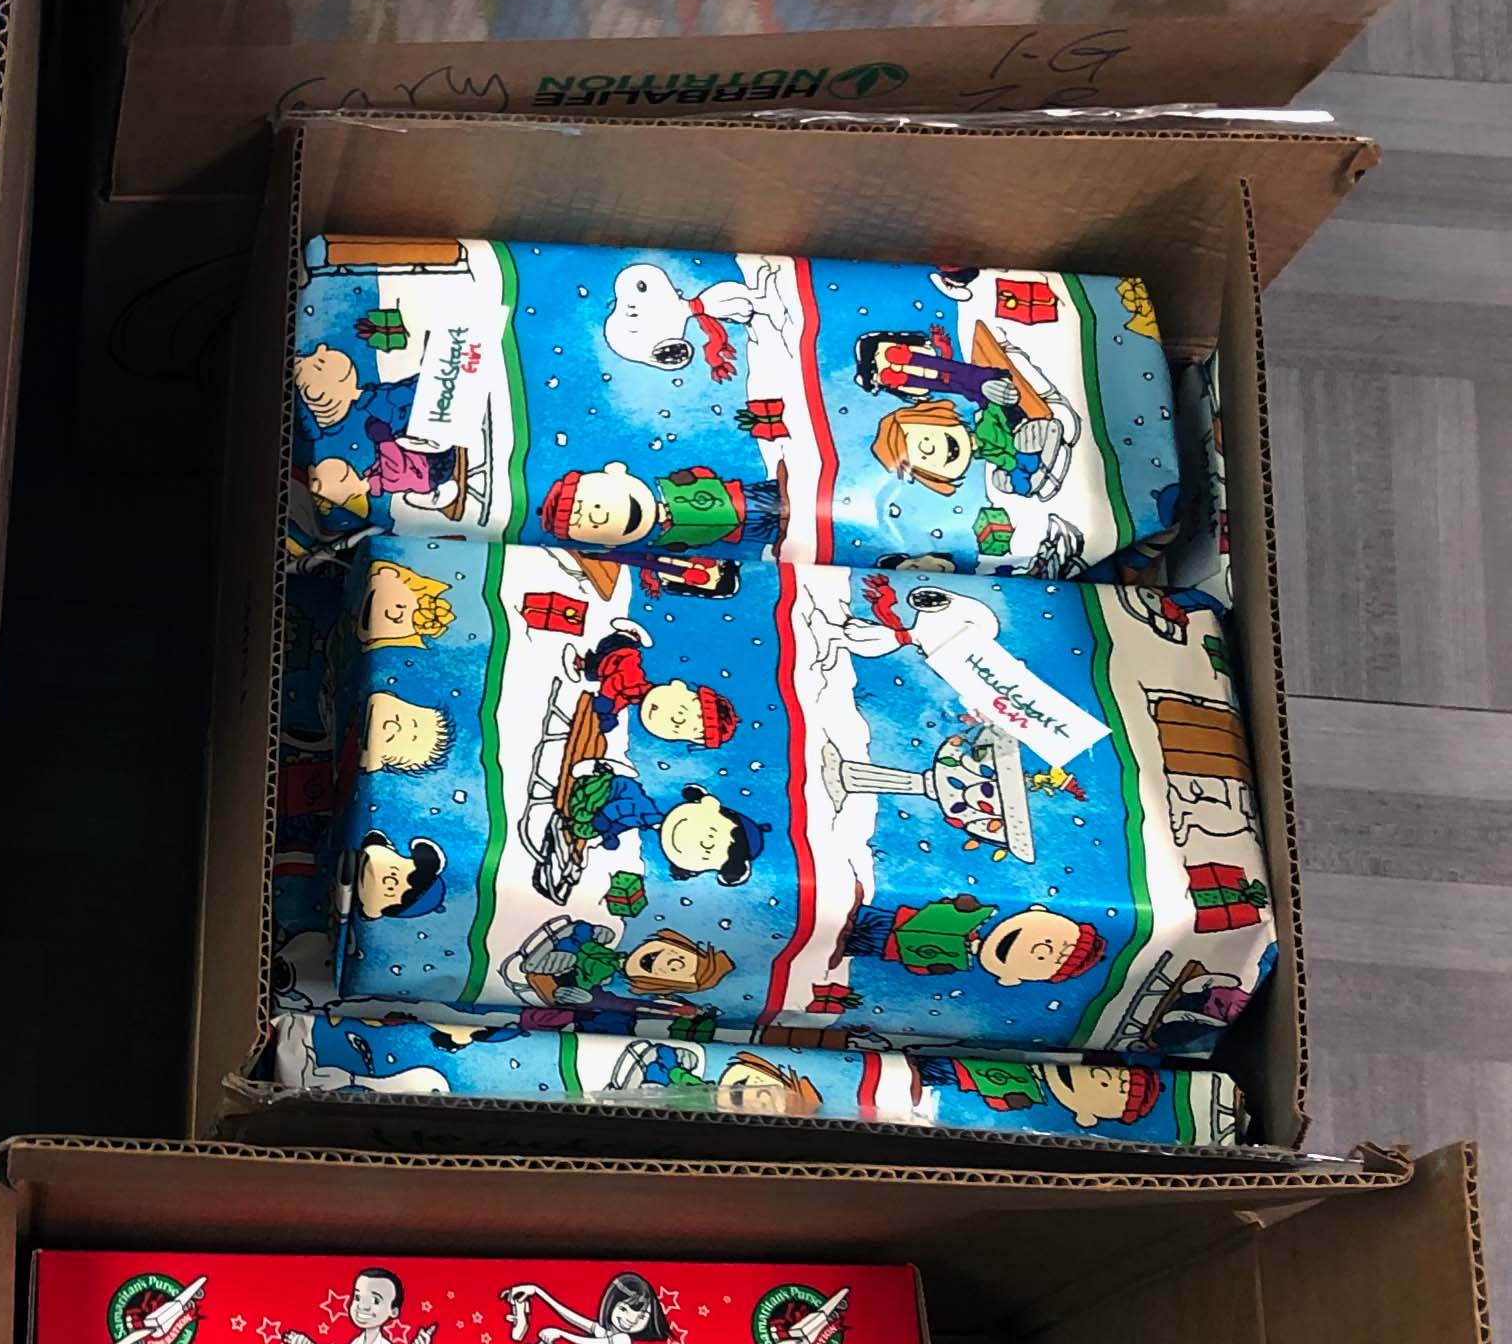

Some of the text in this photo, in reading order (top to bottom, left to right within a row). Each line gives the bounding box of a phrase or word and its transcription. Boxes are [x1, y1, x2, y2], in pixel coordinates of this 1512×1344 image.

[536, 66, 829, 93] NUTRITION
[532, 82, 820, 107] HERBALIFE
[148, 1275, 180, 1297] Purse
[790, 1286, 823, 1307] Purse
